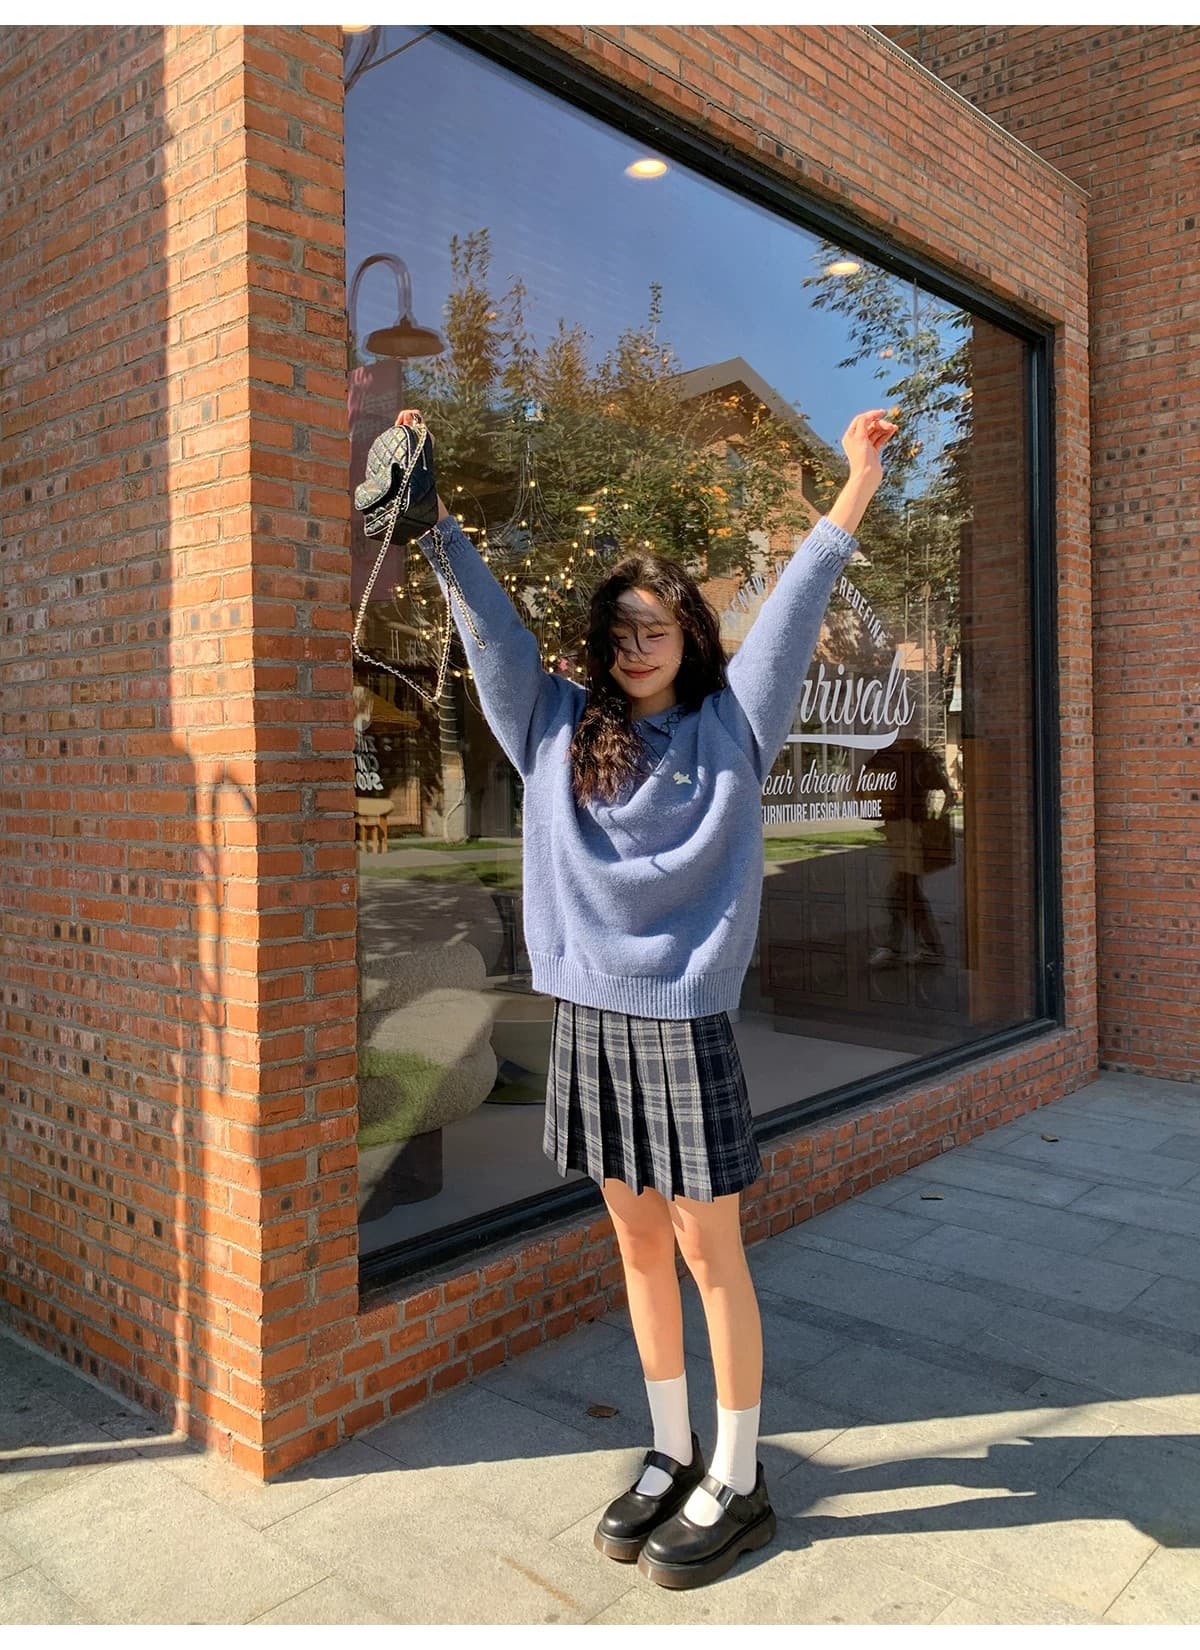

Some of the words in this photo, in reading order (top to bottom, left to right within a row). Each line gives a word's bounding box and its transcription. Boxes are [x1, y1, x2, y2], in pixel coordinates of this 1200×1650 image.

[839, 575, 888, 649] REDEFINE
[800, 648, 916, 726] rrivals
[762, 768, 795, 795] our
[800, 759, 853, 794] dream
[856, 764, 897, 792] home
[762, 803, 808, 825] URNITURE
[809, 801, 840, 821] DESIGN
[842, 800, 859, 819] AND
[860, 799, 883, 818] MORE
